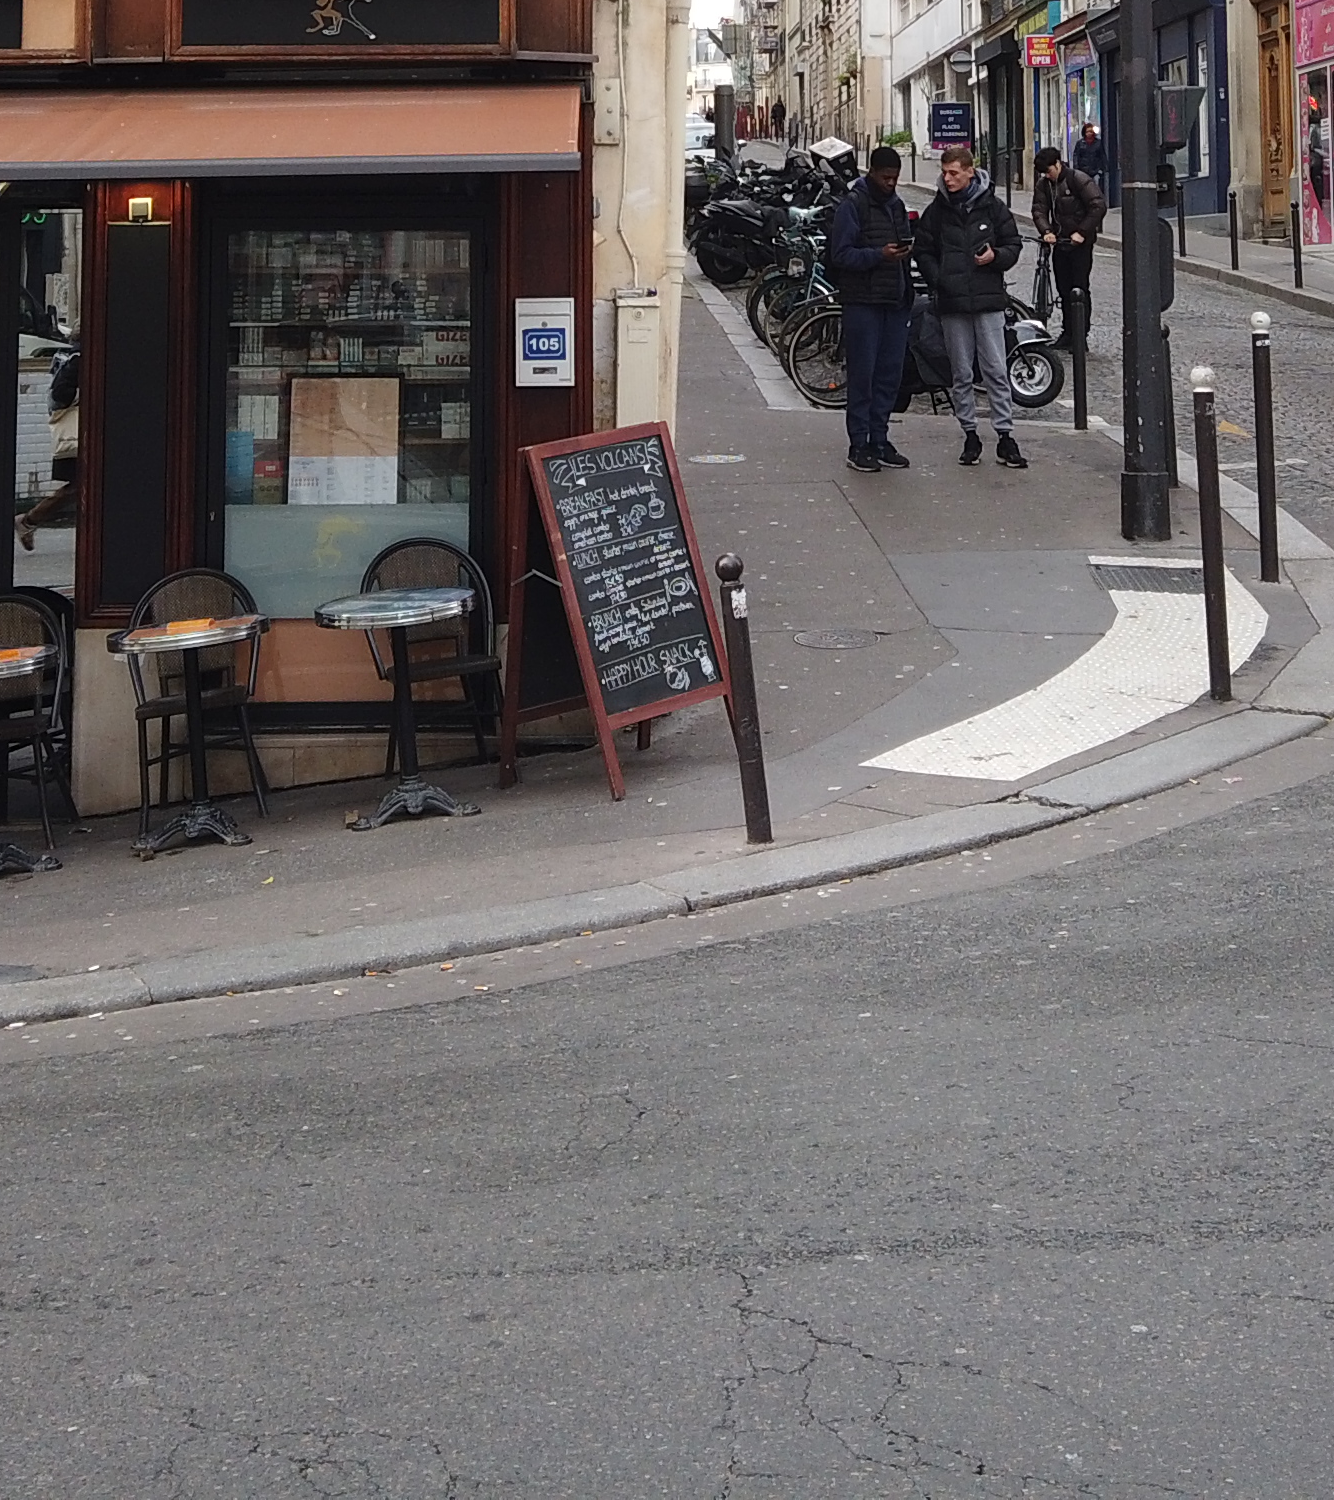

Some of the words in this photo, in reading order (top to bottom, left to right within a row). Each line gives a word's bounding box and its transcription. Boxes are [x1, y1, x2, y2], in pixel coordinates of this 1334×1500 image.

[1032, 55, 1051, 65] OPEN
[529, 337, 560, 351] 105
[572, 454, 596, 476] LES
[596, 445, 646, 471] VOLCANS
[559, 487, 605, 516] BREAKFAST
[607, 488, 620, 501] hot
[574, 549, 600, 568] LUNCH
[591, 608, 623, 632] BRUNCH
[603, 659, 632, 689] HAPPY
[631, 652, 661, 678] HOUR
[659, 642, 694, 667] SNACK
